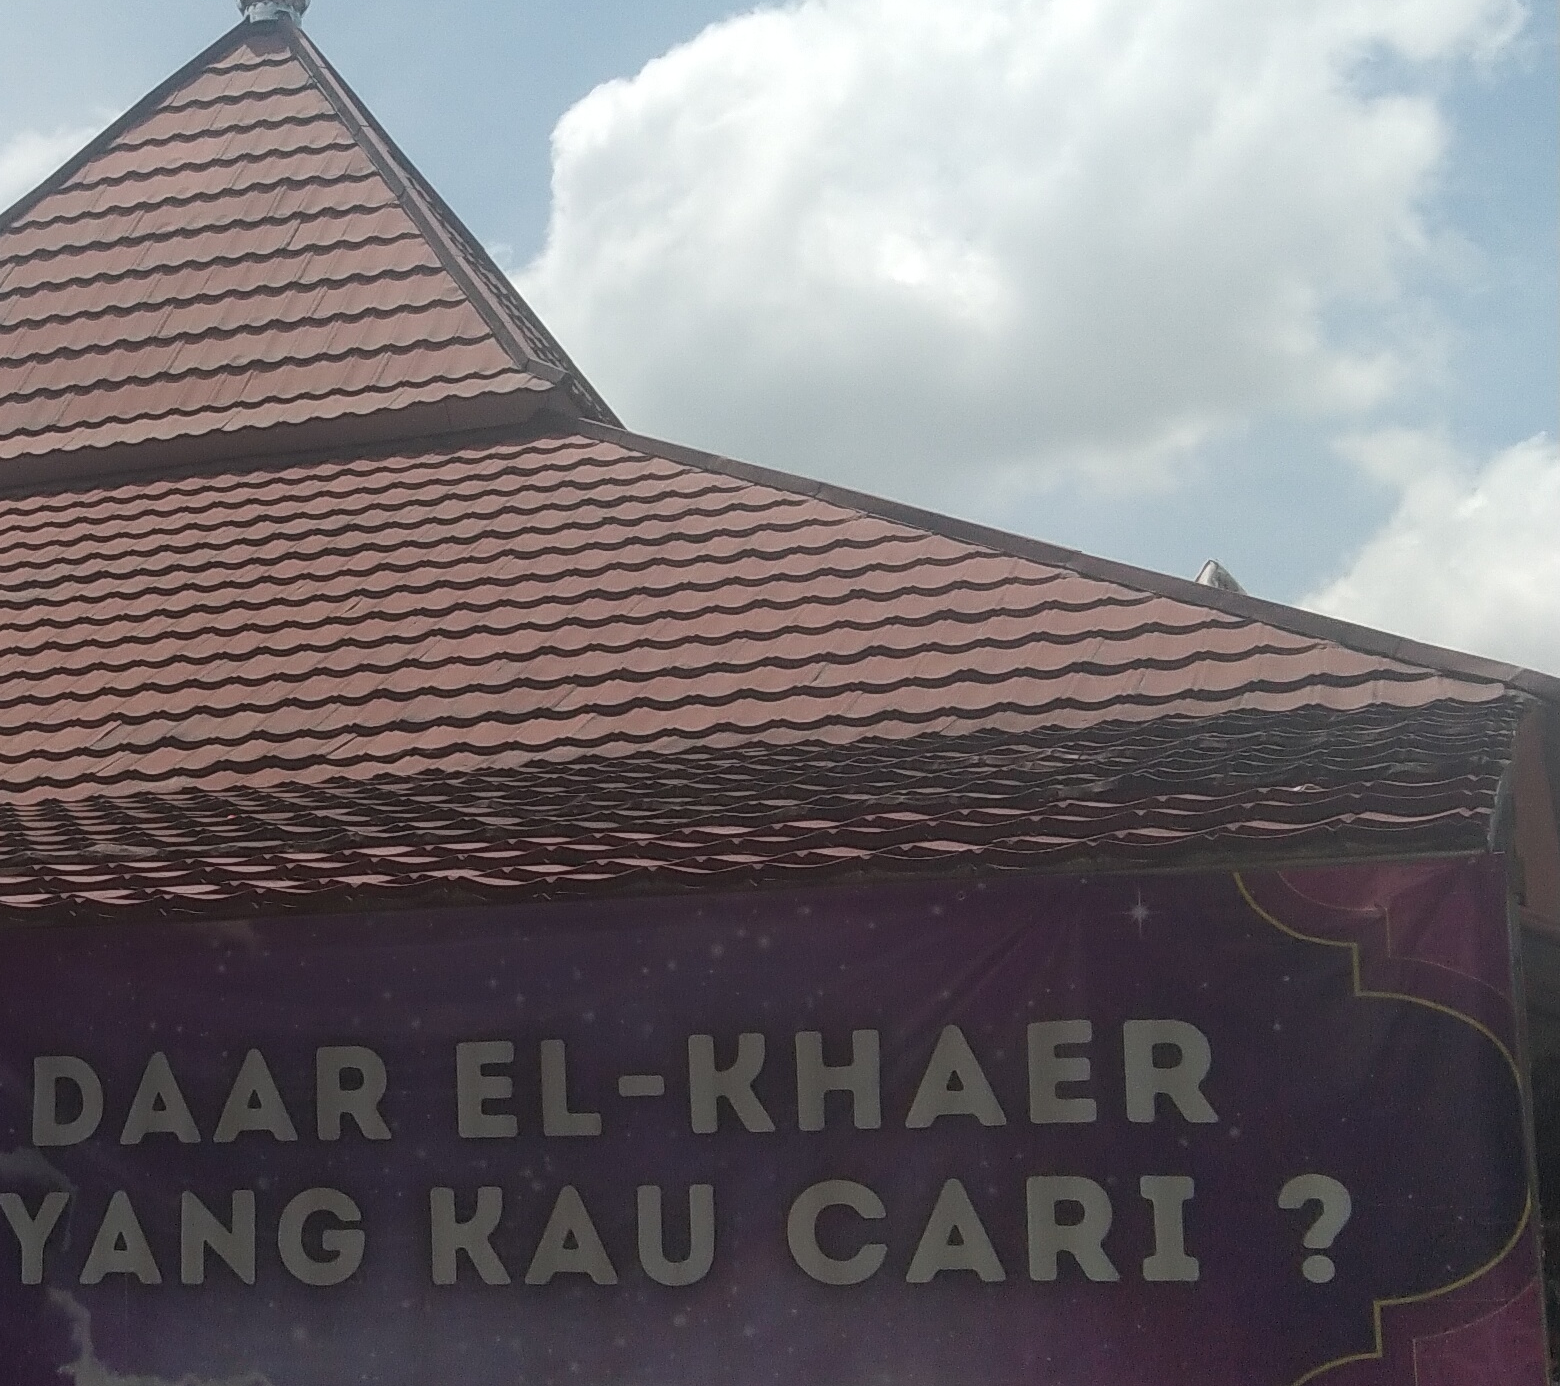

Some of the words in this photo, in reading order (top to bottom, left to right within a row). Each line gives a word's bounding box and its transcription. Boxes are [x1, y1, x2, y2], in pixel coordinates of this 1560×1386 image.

[34, 1046, 391, 1148] DAAR
[457, 1019, 1218, 1137] EL-KHAER
[13, 1188, 365, 1286] YANG
[431, 1184, 714, 1286] KAU
[787, 1176, 1199, 1284] CARI
[1278, 1174, 1351, 1283] ?
